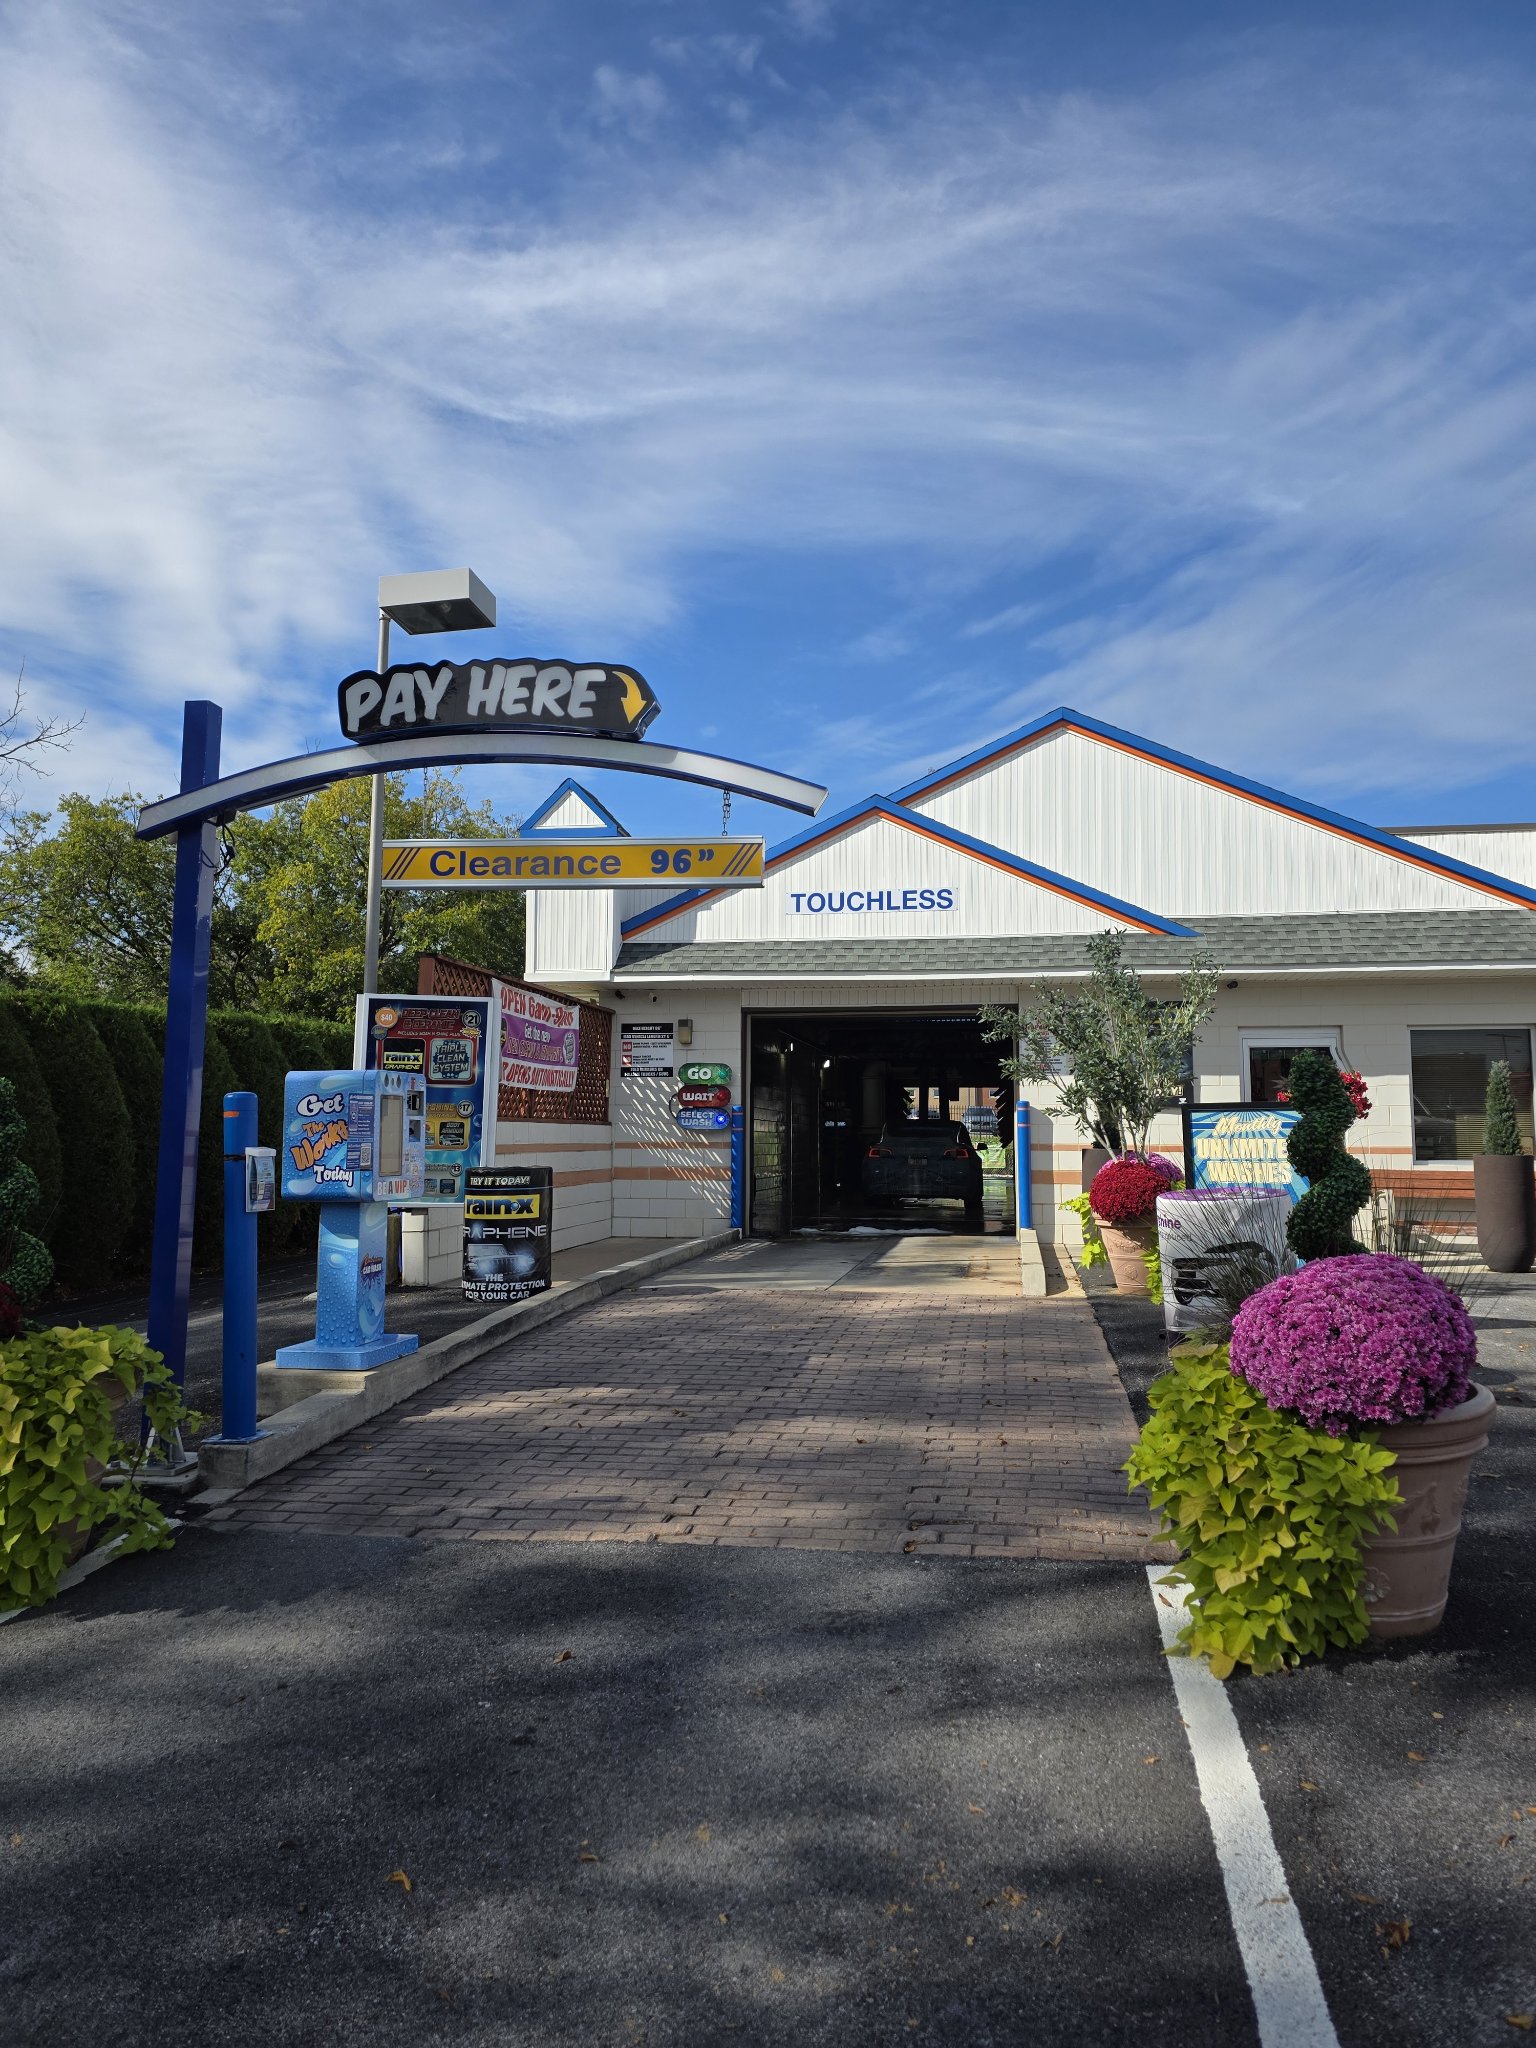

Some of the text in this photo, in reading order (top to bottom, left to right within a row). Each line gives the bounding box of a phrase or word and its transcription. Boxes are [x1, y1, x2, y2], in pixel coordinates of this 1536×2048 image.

[345, 664, 607, 732] PAY HERE
[429, 850, 622, 877] Clearance
[791, 888, 954, 913] TOUCHLESS
[500, 986, 526, 1016] OPEN
[380, 1013, 393, 1022] $40
[465, 1014, 478, 1025] $21
[436, 1043, 467, 1052] TRIPLE
[436, 1053, 466, 1063] CLEAN
[433, 1062, 469, 1074] SYSTEM
[687, 1067, 712, 1080] GO
[506, 1063, 531, 1085] OPENS
[530, 1067, 576, 1088] AUTOMATICALLY
[682, 1092, 715, 1101] WAIT
[297, 1093, 344, 1117] Get
[459, 1103, 471, 1112] $17
[680, 1111, 715, 1119] SELECT
[681, 1118, 713, 1126] WASH
[1213, 1115, 1283, 1136] Monthly
[303, 1121, 325, 1137] The
[1195, 1137, 1289, 1159] UNLIMITE
[314, 1164, 354, 1187] Today
[1206, 1160, 1293, 1184] WASHES
[470, 1175, 531, 1186] TRY IT TODAY!
[377, 1181, 387, 1196] BE
[388, 1180, 393, 1195] A
[461, 1224, 547, 1239] RAPHENE
[362, 1263, 382, 1275] CAR WASH
[484, 1273, 504, 1282] THE
[487, 1279, 546, 1291] PROTECTION
[465, 1290, 530, 1300] FOR YOUR CAR
